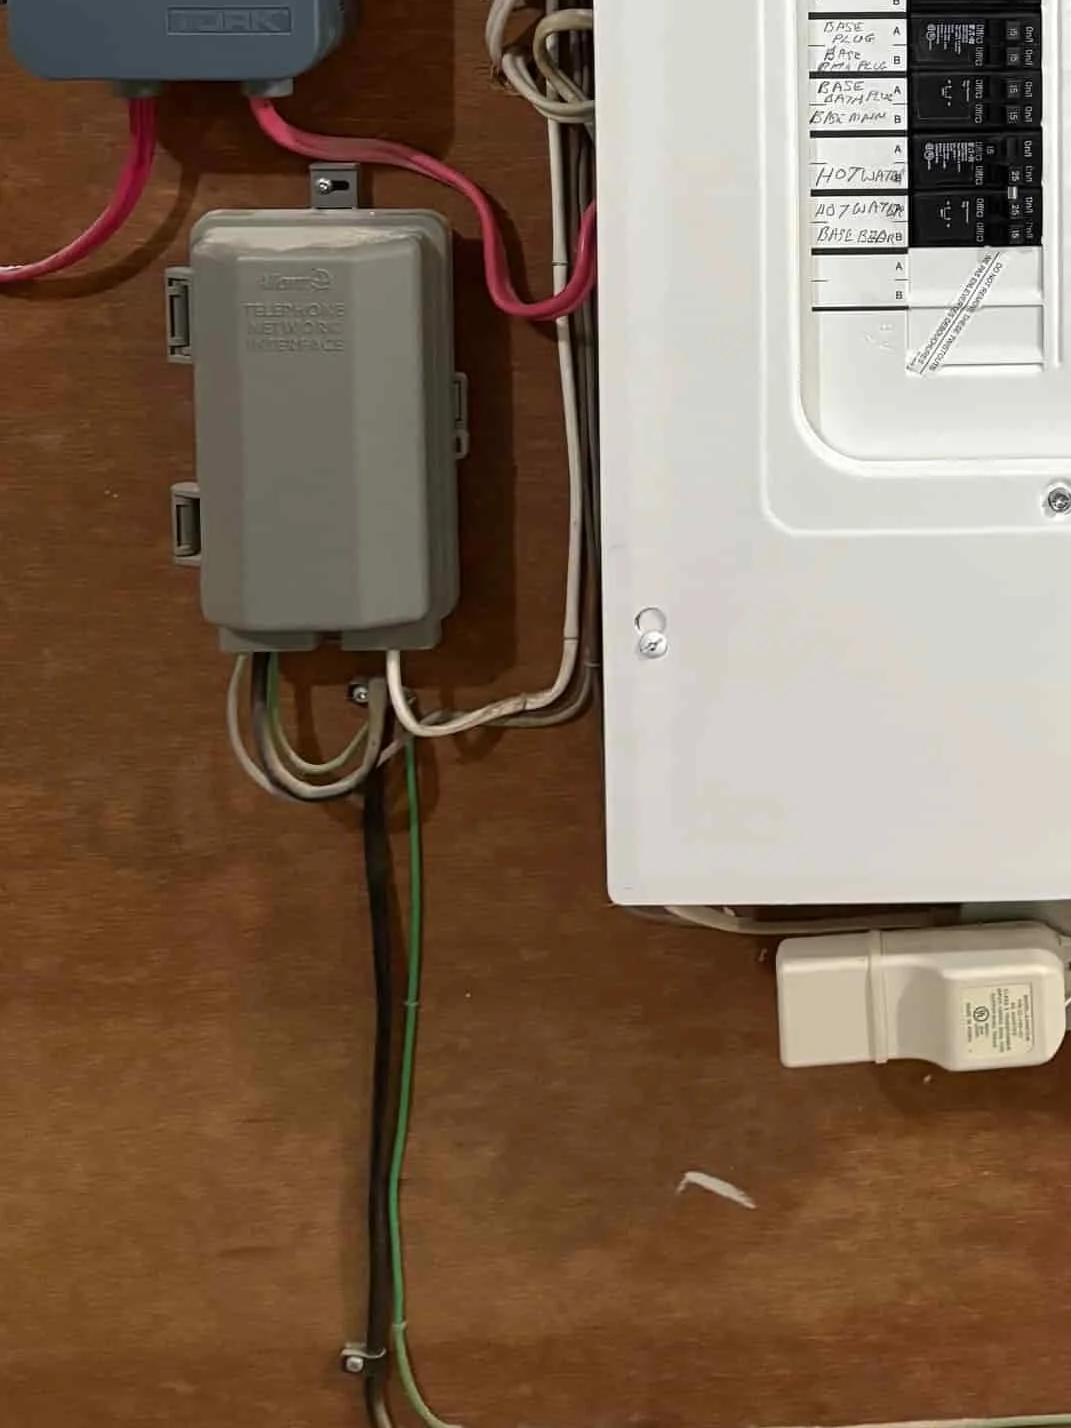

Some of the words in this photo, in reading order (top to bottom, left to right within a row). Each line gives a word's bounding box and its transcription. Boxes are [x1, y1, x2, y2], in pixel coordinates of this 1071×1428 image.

[824, 21, 864, 33] BASE
[893, 26, 900, 35] A
[832, 33, 876, 44] PLUG
[893, 56, 900, 65] B
[818, 81, 864, 94] BASE
[816, 166, 865, 187] HOT
[993, 262, 1002, 272] DO
[984, 273, 995, 285] NOT
[242, 302, 345, 318] TELEPHONE
[247, 338, 345, 352] INTERFACE
